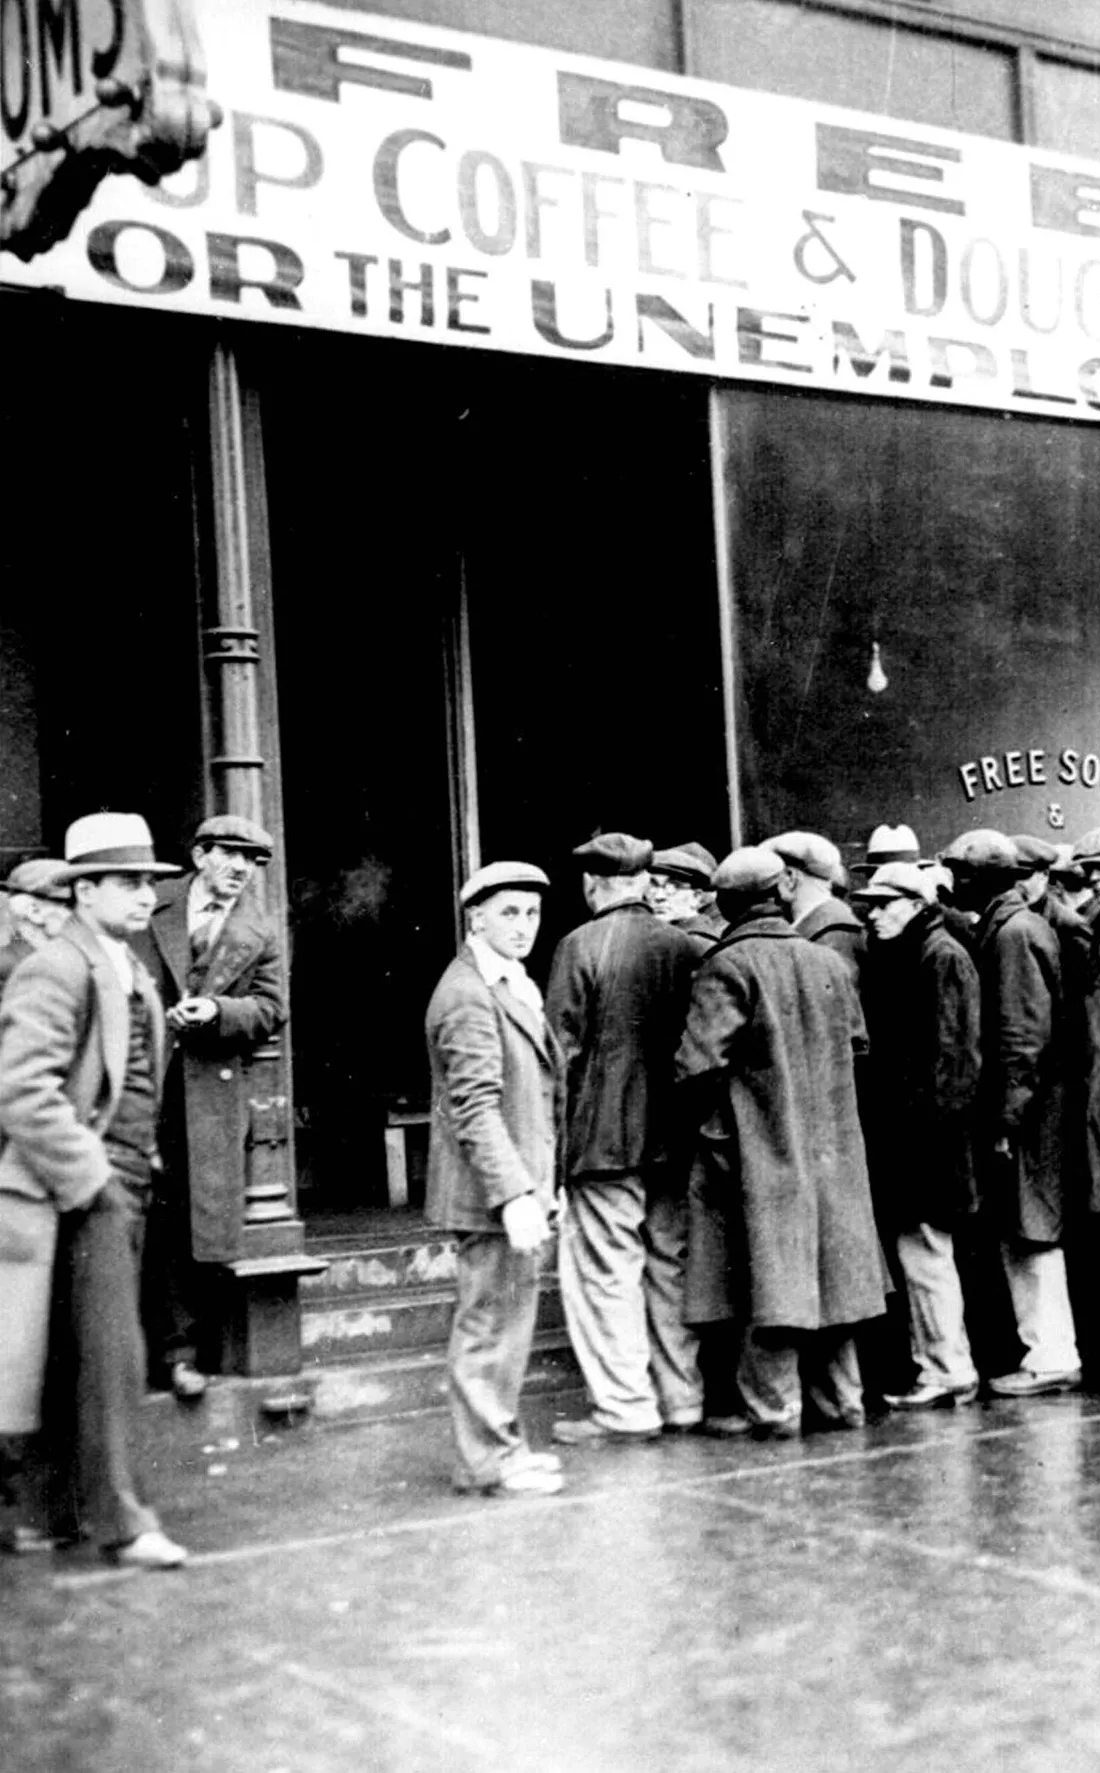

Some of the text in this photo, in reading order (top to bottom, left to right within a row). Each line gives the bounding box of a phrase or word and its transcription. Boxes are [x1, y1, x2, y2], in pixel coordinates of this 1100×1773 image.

[373, 128, 748, 290] COFFEE
[793, 209, 856, 284] &
[334, 251, 491, 334] THE
[958, 750, 1047, 801] FREE
[1048, 803, 1064, 829] &
